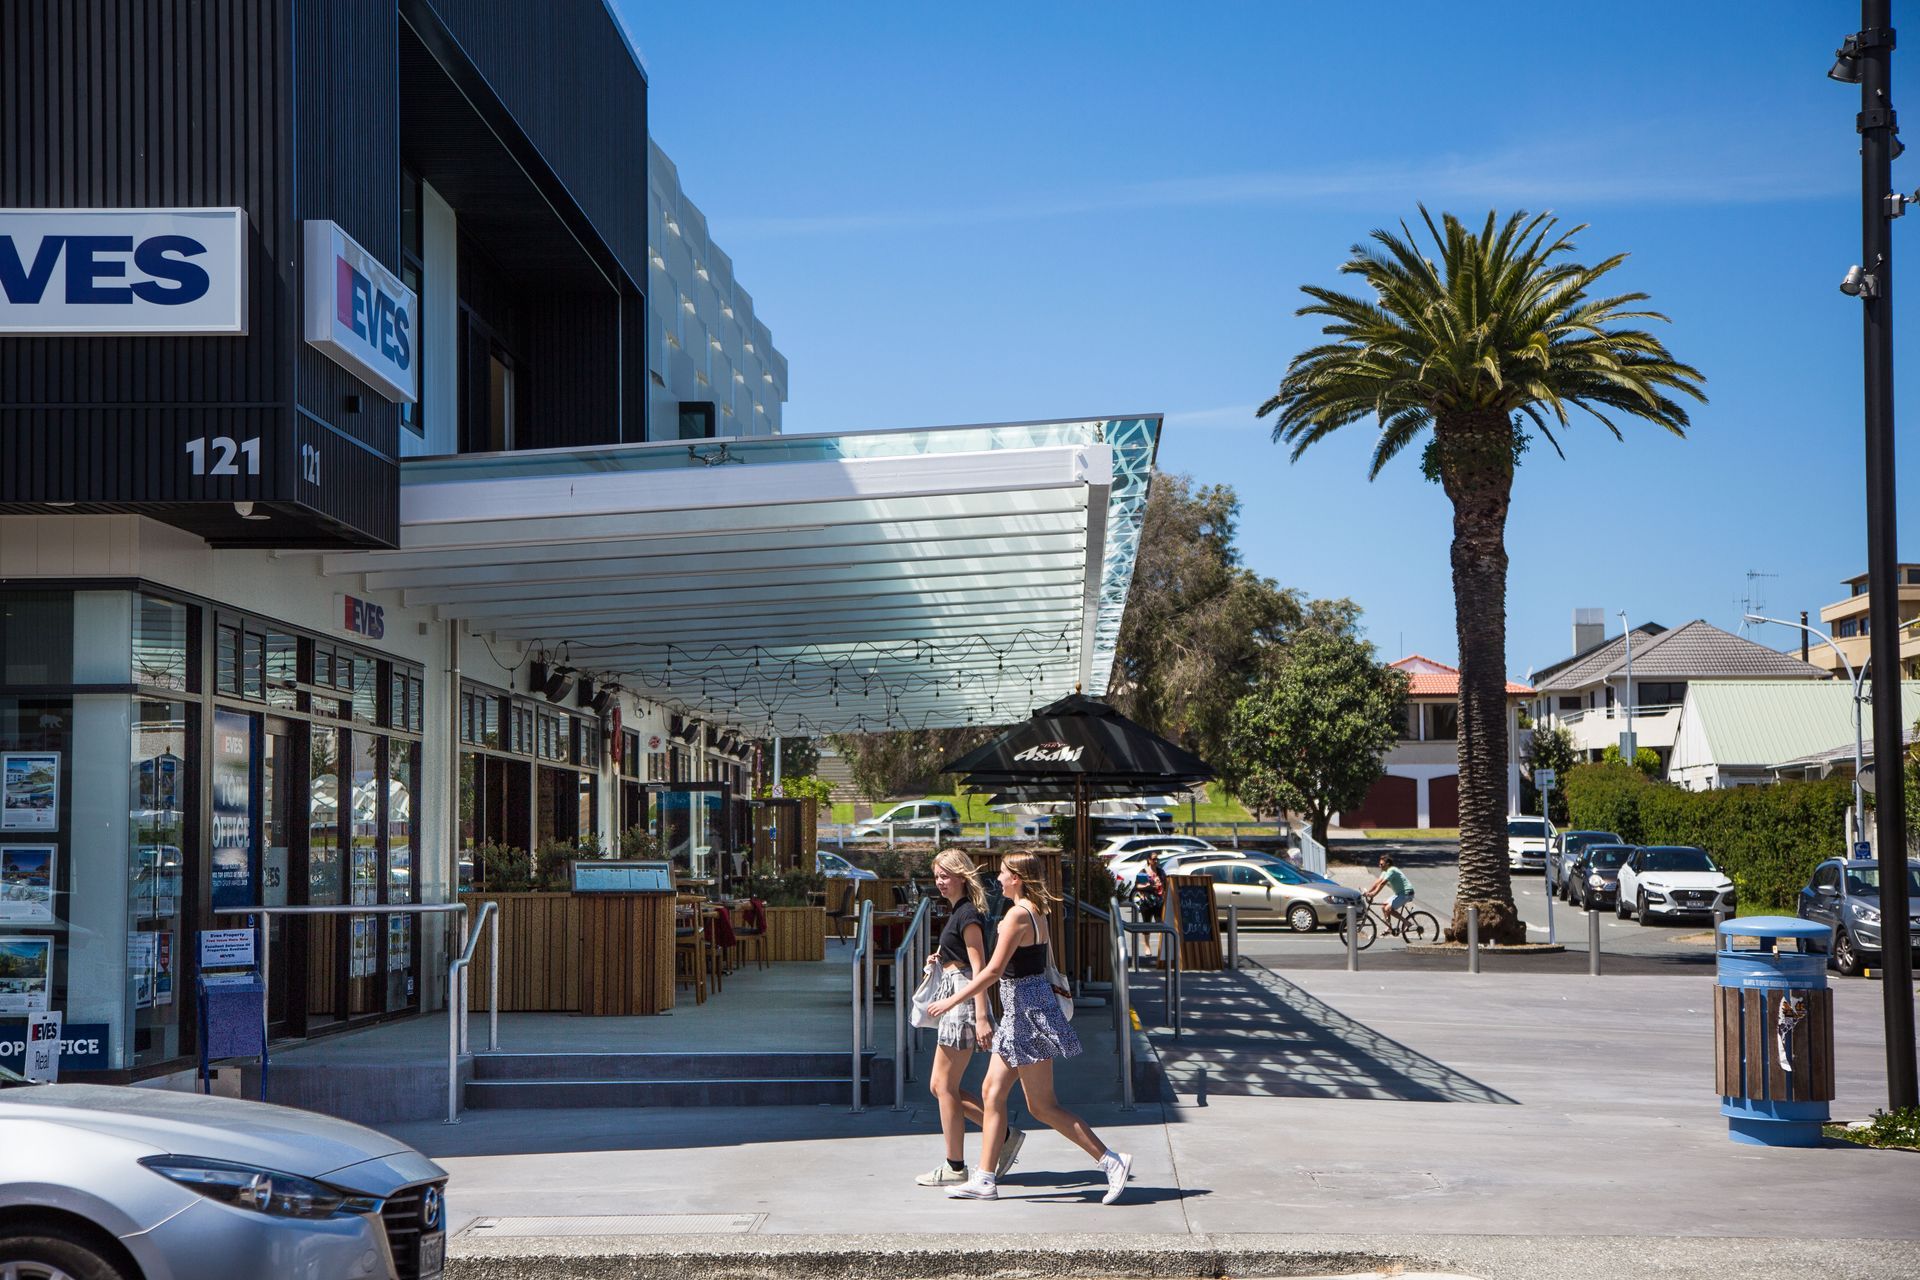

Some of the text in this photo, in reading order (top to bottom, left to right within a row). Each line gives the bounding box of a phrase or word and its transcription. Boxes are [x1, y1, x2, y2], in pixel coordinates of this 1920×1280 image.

[352, 268, 410, 371] EVES
[186, 437, 260, 475] 121
[302, 443, 320, 487] 121
[352, 597, 385, 640] EVES
[225, 736, 243, 754] EVES
[1013, 745, 1085, 762] Asahi
[212, 816, 250, 849] OFFICE
[37, 1023, 57, 1040] EVES
[0, 1041, 25, 1056] OP
[35, 1050, 50, 1070] Real
